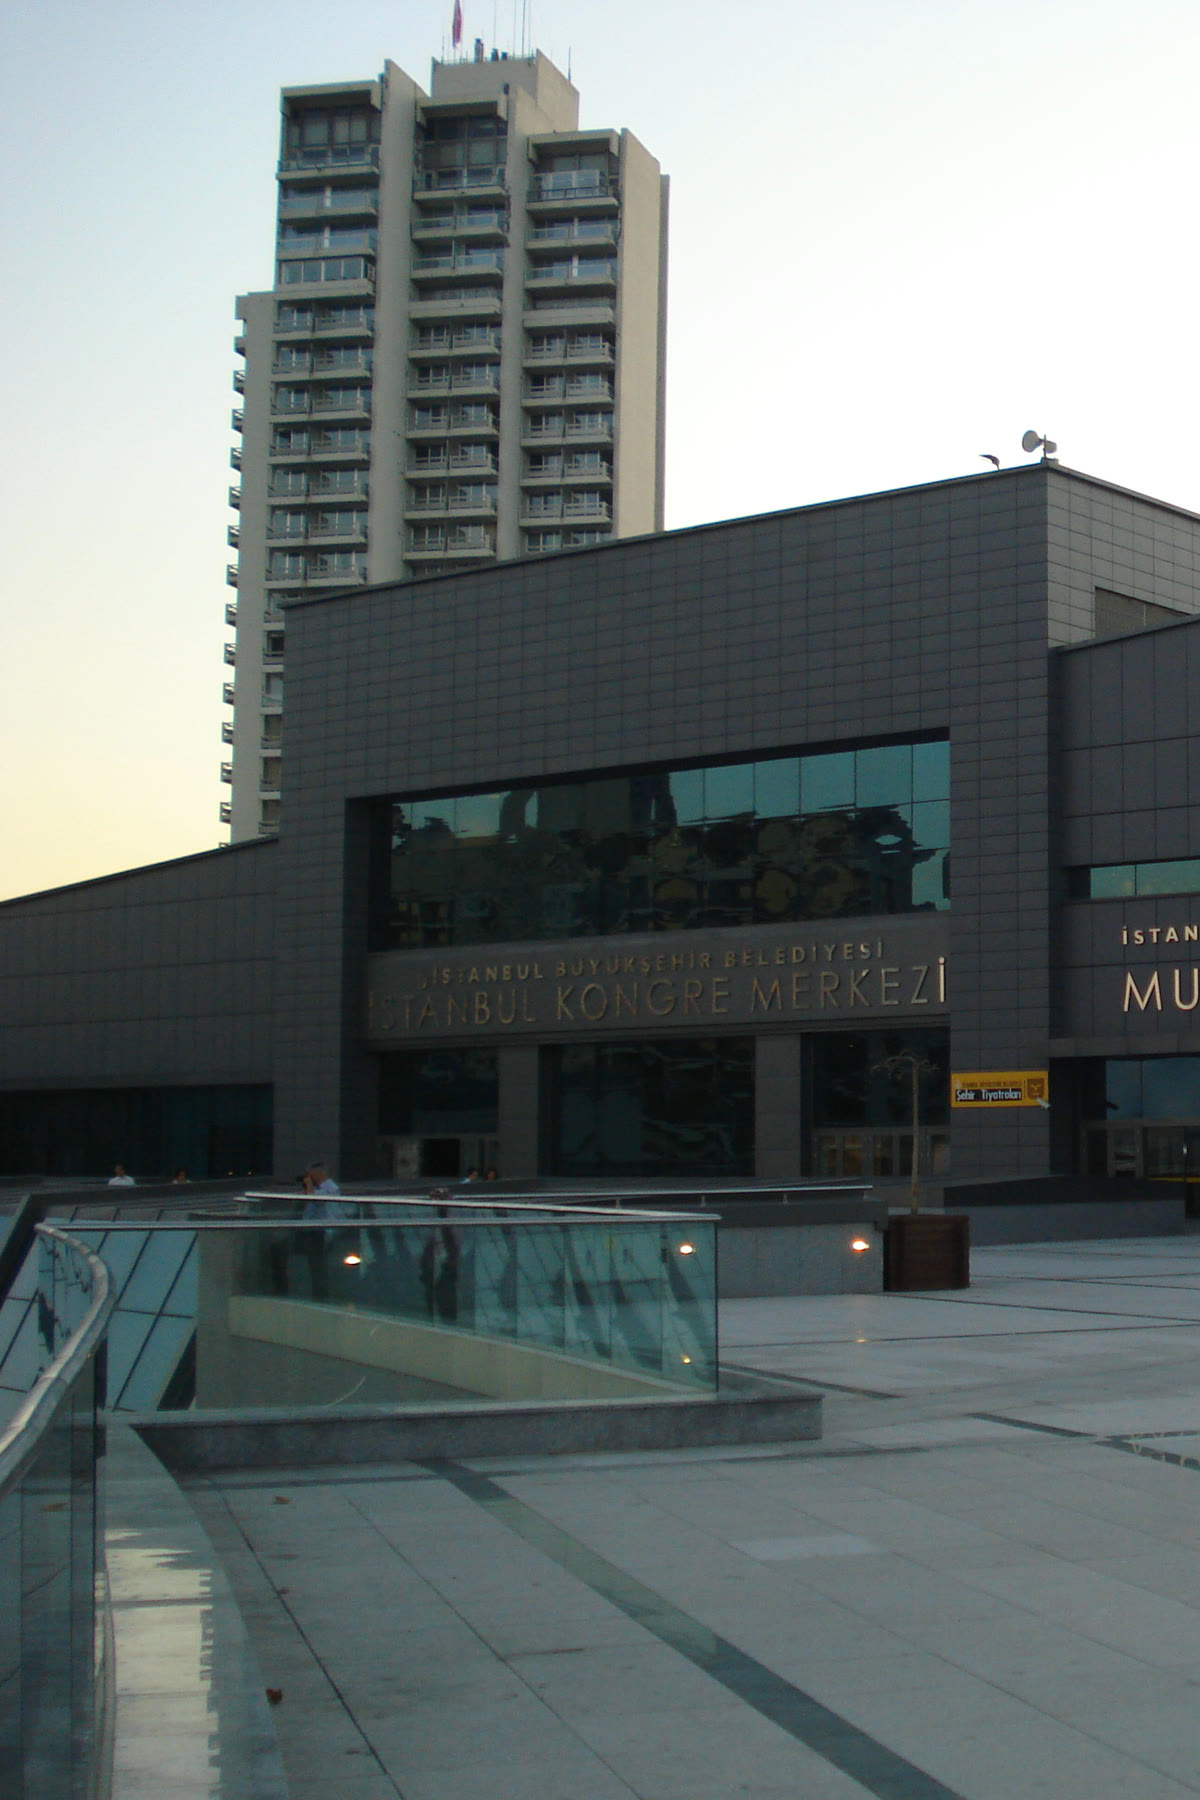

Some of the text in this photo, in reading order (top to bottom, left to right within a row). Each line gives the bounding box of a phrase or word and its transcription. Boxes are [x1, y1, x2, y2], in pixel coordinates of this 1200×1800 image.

[724, 937, 885, 967] BELEDİYESİ
[556, 976, 730, 1022] KONGRE
[750, 956, 947, 1013] MERKEZİ
